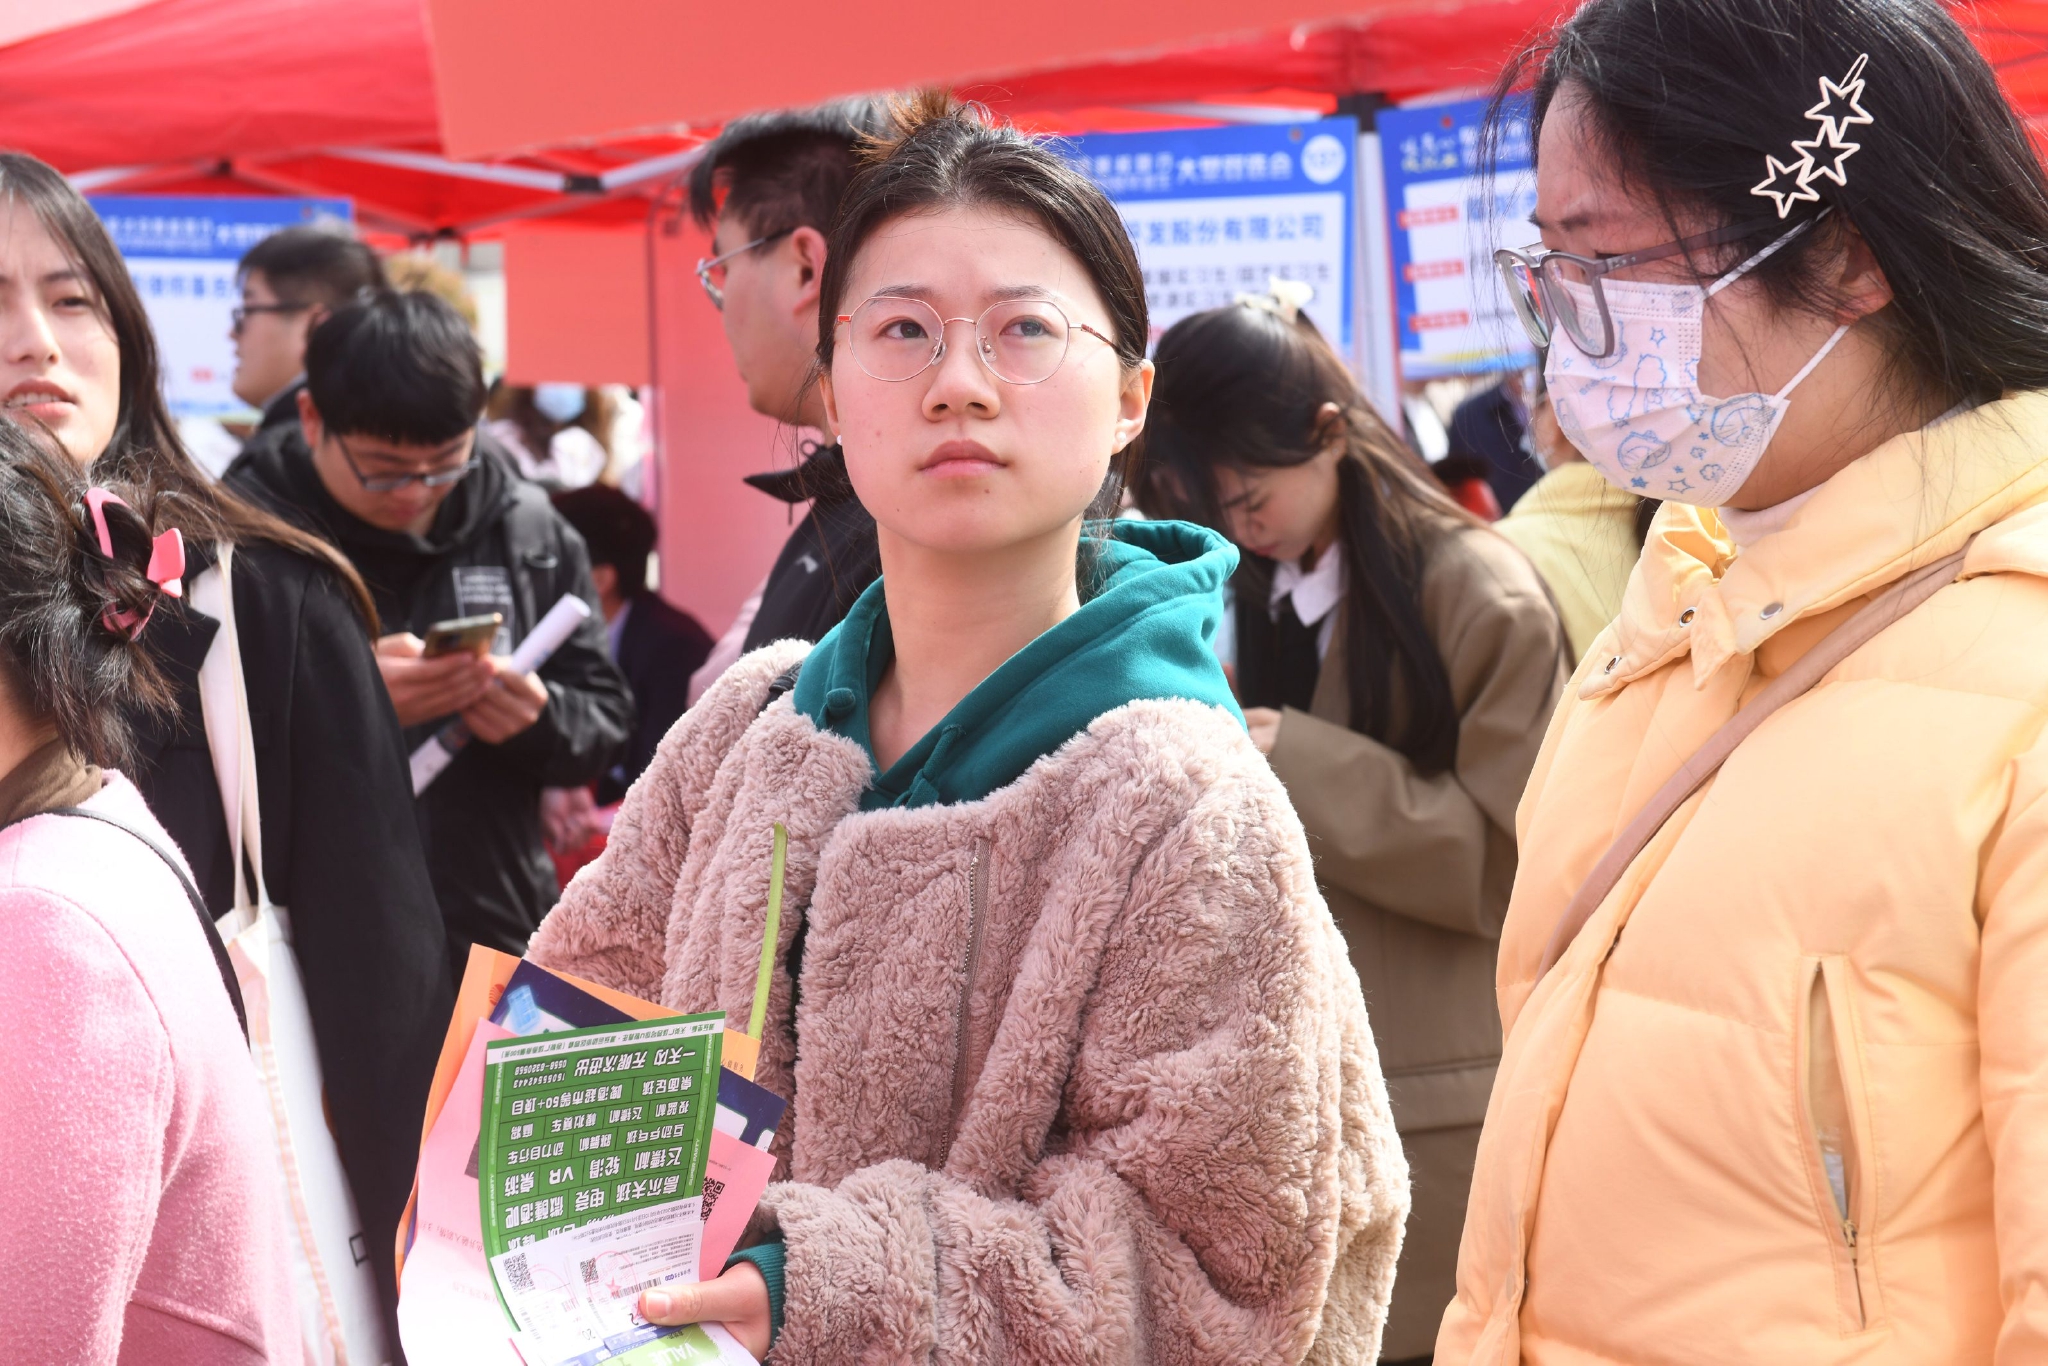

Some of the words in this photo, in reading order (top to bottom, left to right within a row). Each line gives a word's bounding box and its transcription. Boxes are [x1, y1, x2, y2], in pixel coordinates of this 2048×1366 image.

[574, 1050, 648, 1077] 无限次进出
[654, 1046, 696, 1066] 一天内
[642, 1076, 693, 1096] 桌面足球
[511, 1084, 623, 1116] 啤酒超市等50+项目
[655, 1100, 690, 1118] 投篮机
[551, 1113, 598, 1133] 模拟赛车
[609, 1106, 643, 1124] 飞镖机
[511, 1123, 534, 1140] 麻将
[626, 1123, 685, 1145] 互动乒乓球
[507, 1141, 565, 1165] 动力自行车
[579, 1134, 612, 1152] 跳舞机
[589, 1156, 621, 1179] 轮滑
[634, 1146, 683, 1171] 飞镖机
[504, 1171, 535, 1197] 桌游
[549, 1166, 575, 1185] VR
[615, 1174, 680, 1203] 高尔夫球
[574, 1188, 605, 1212] 电竞
